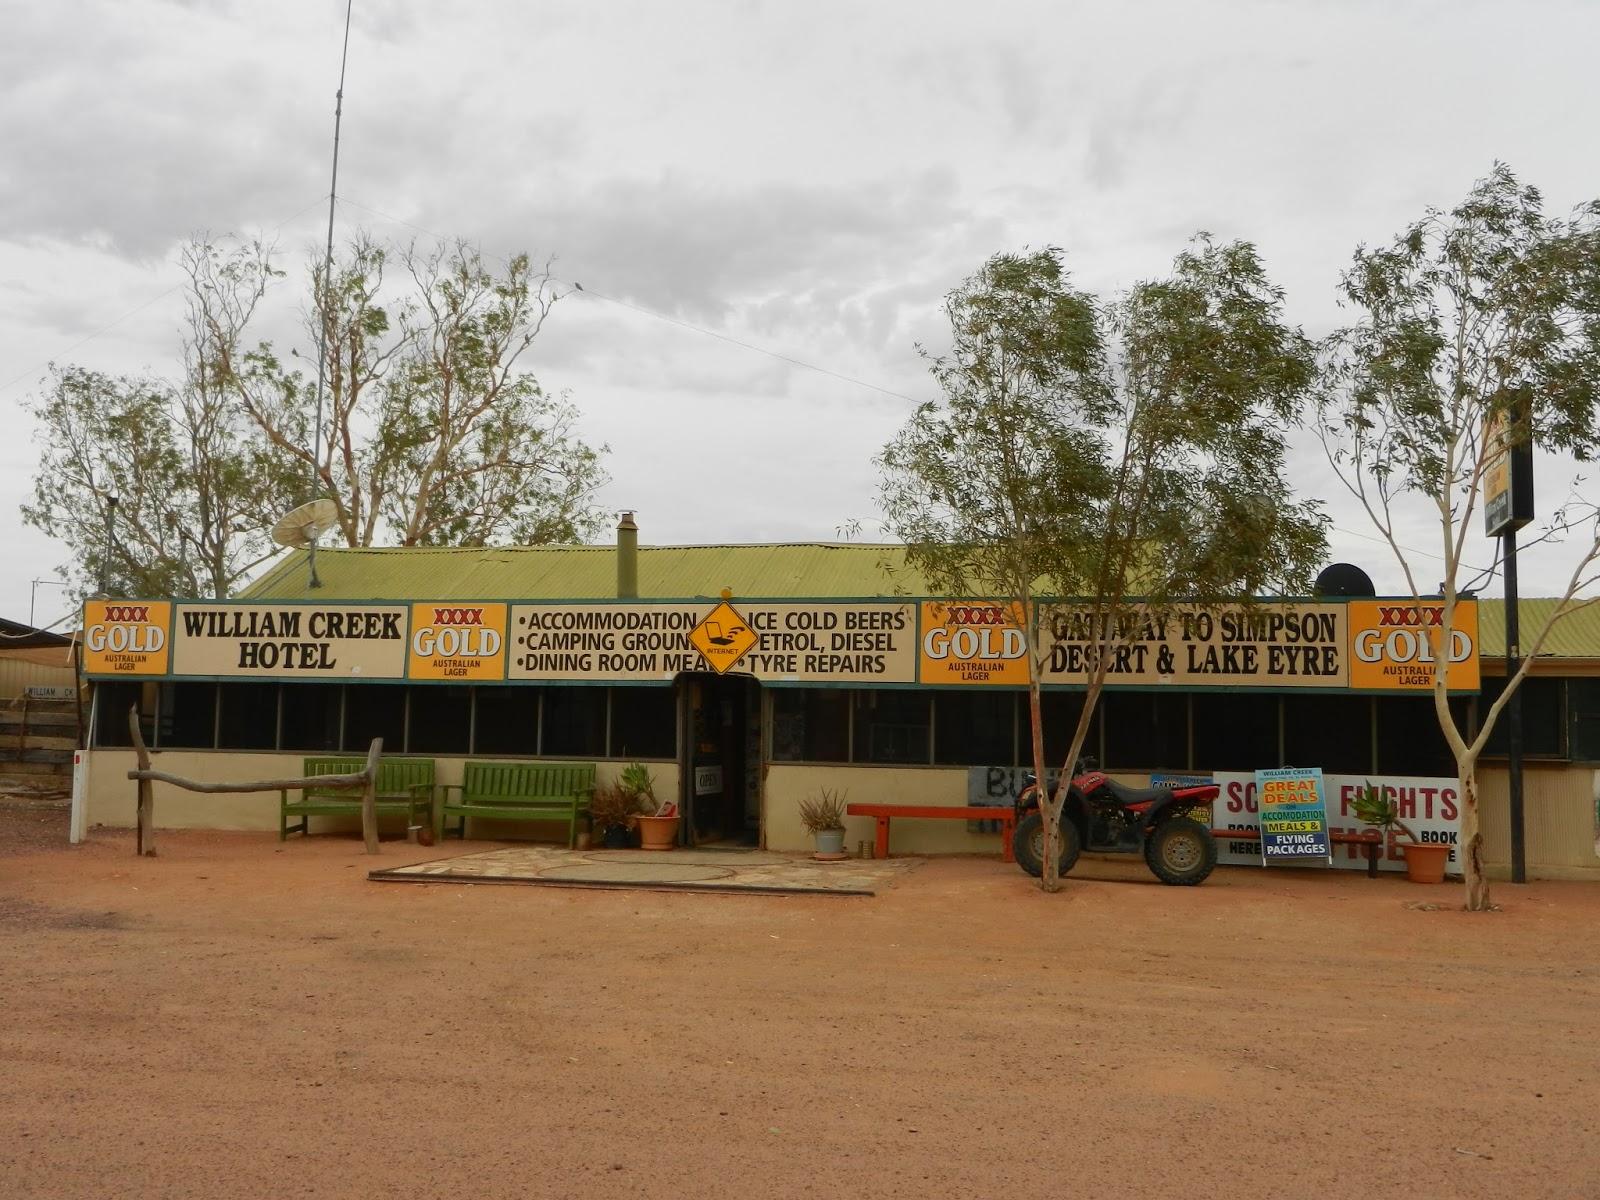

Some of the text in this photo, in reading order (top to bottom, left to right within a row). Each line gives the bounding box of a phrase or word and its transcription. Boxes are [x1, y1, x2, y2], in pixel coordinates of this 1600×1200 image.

[104, 606, 149, 622] XXXX
[433, 608, 484, 625] XXXX
[528, 612, 696, 630] ACCOMMODATION
[748, 612, 905, 631] ICE COLD BEERS
[947, 607, 1004, 624] XXXX
[1379, 607, 1445, 625] XXXX
[182, 611, 402, 640] WILLIAM CREEK
[1182, 612, 1213, 642] TO
[1220, 612, 1337, 643] SIMPSON
[85, 623, 166, 654] GOLD
[412, 626, 502, 658] GOLD
[526, 632, 696, 651] CAMPING GROUN
[757, 633, 898, 653] ETROL, DIESEL
[924, 628, 1027, 660] GOLD
[1354, 629, 1472, 662] GOLD
[103, 654, 147, 664] AUSTRALIAN
[237, 642, 337, 670] HOTEL
[432, 659, 481, 669] AUSTRALIAN
[525, 653, 713, 672] DINING ROOM MEA
[748, 654, 885, 674] TYRE REPAIRS
[1156, 644, 1175, 674] &
[1187, 645, 1259, 674] LAKE
[1267, 646, 1339, 675] EYRE
[113, 662, 136, 672] LAGER
[443, 667, 468, 677] LAGER
[948, 662, 1004, 672] AUSTRALIAN
[1383, 666, 1440, 675] AUSTRALI
[962, 672, 989, 681] LAGER
[1399, 676, 1430, 685] LAGER
[700, 775, 718, 787] OPEN
[1263, 779, 1316, 792] GREAT
[1264, 792, 1318, 804] DEALS
[1262, 811, 1325, 821] ACCOMODATION
[1268, 822, 1319, 832] MEALS &
[1276, 834, 1315, 844] FLYING
[1421, 830, 1458, 844] BOOK
[1229, 841, 1261, 854] HERE
[1267, 844, 1326, 855] PACKAGES
